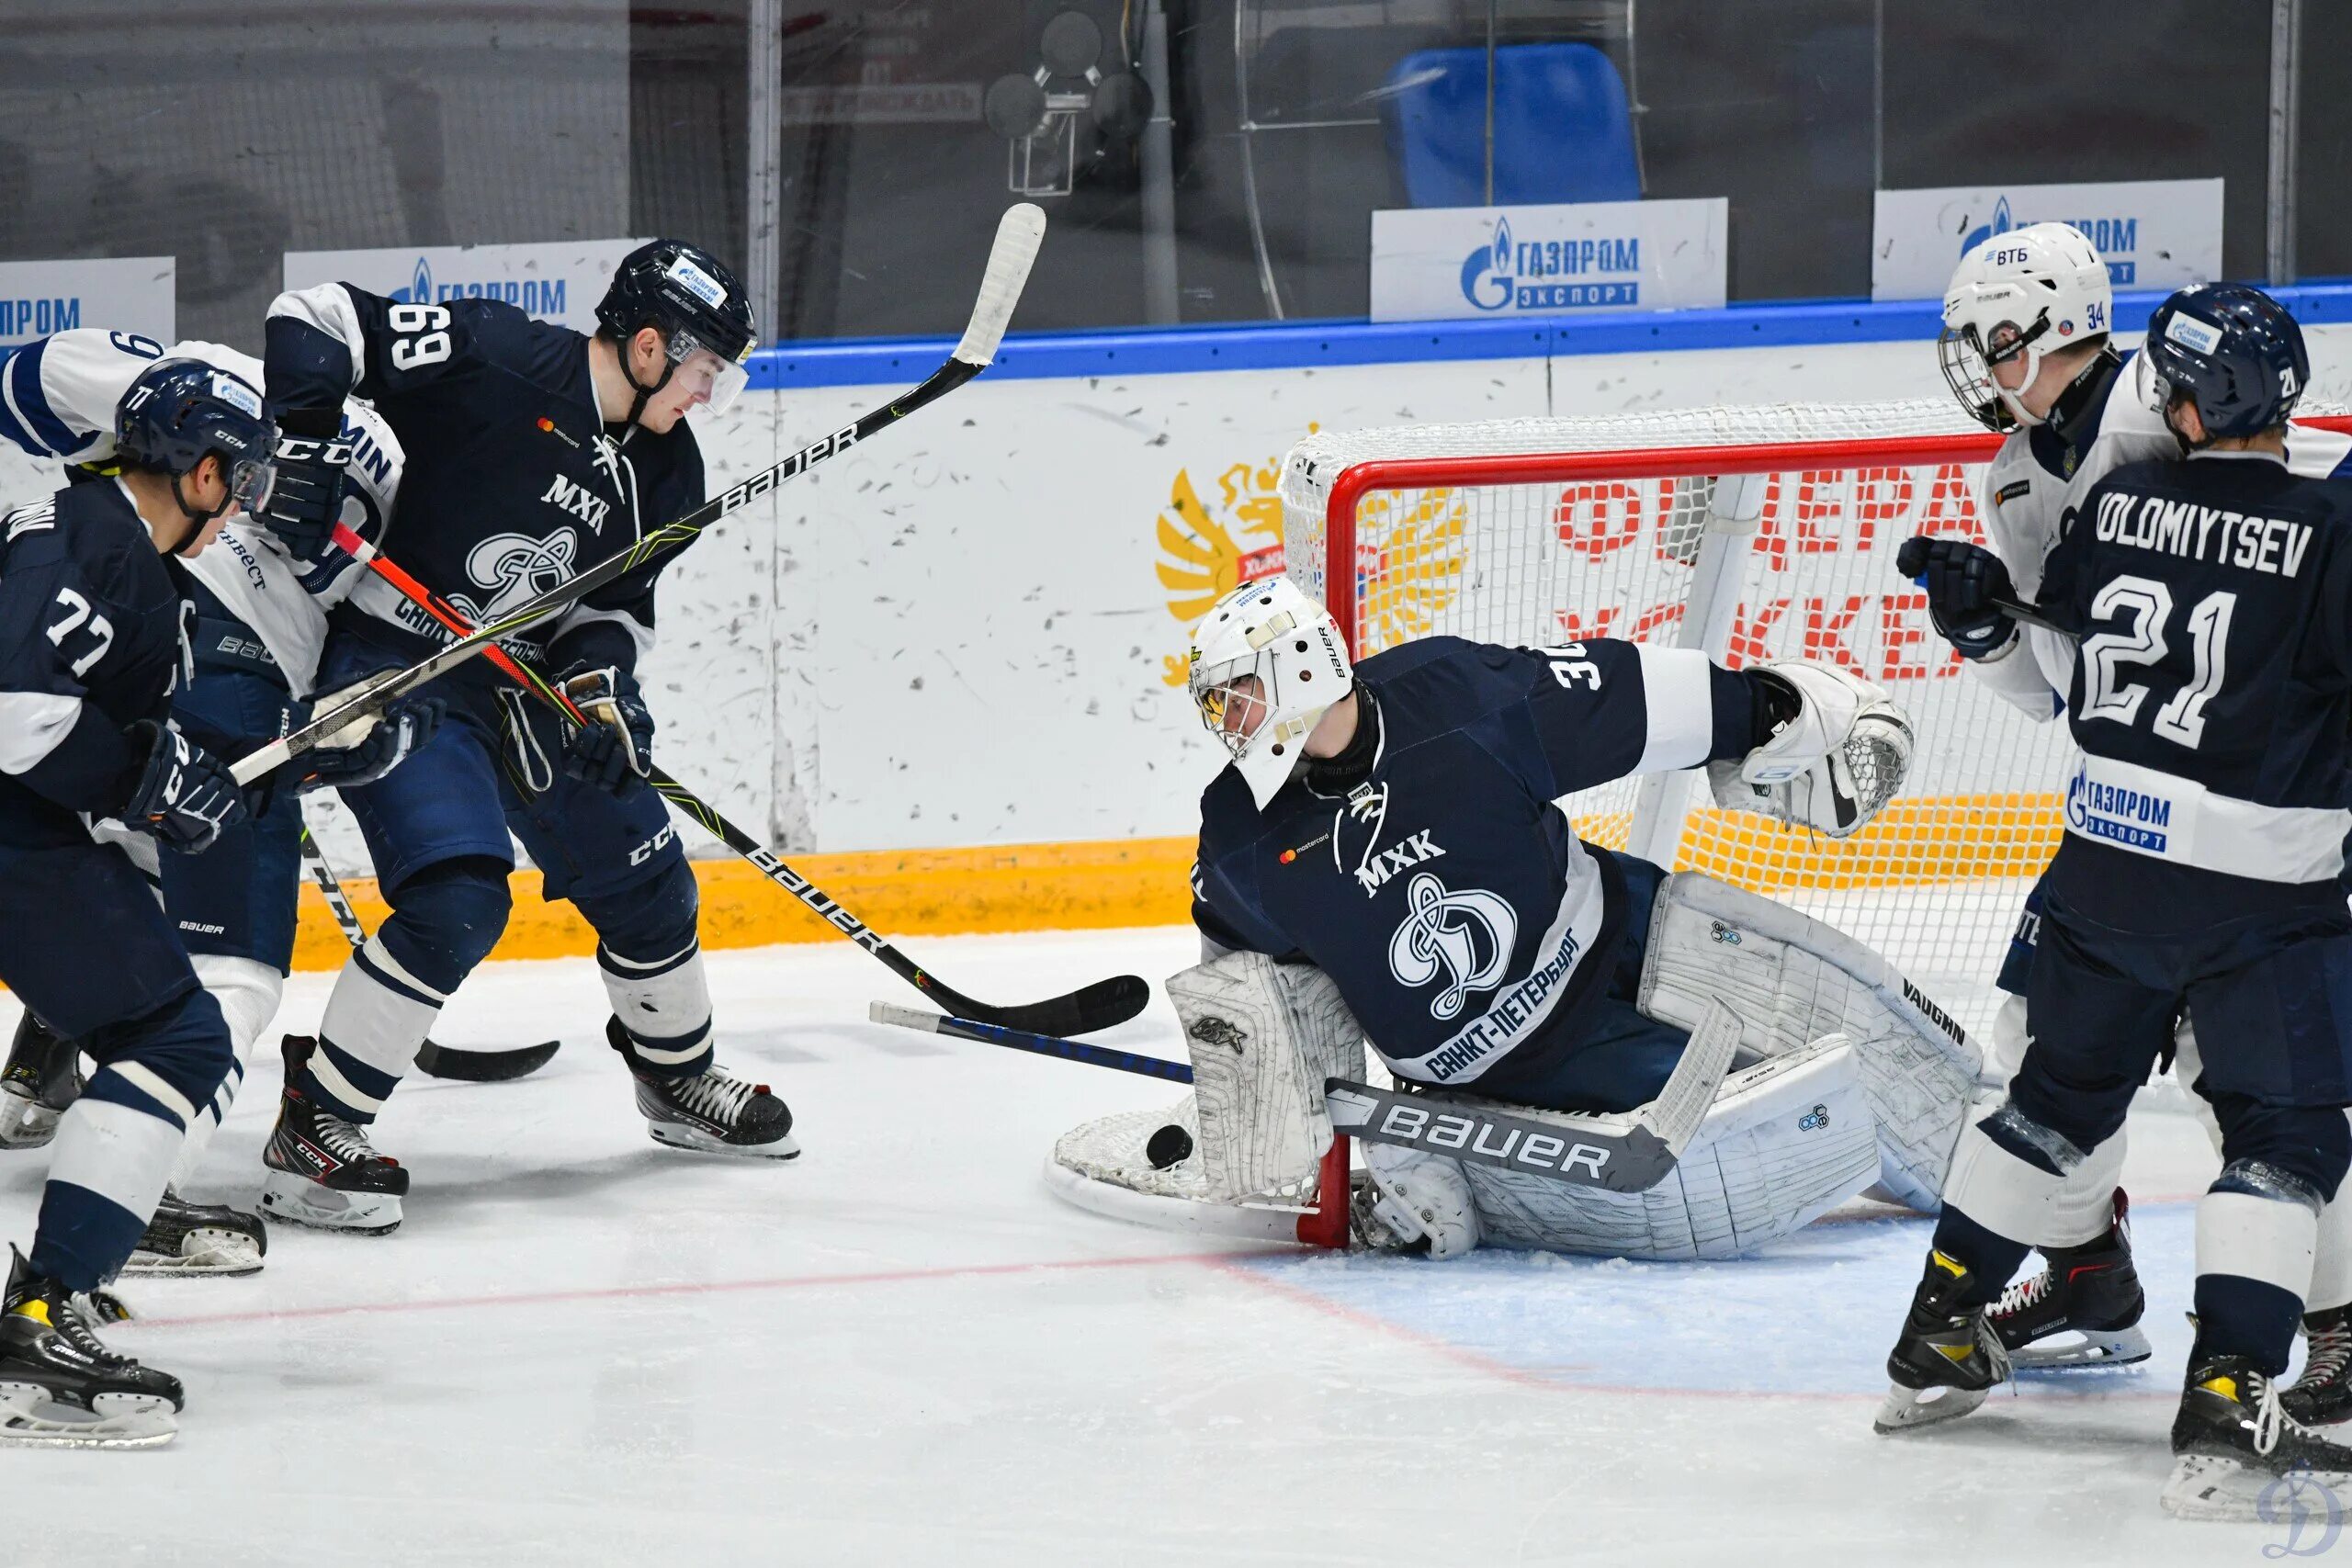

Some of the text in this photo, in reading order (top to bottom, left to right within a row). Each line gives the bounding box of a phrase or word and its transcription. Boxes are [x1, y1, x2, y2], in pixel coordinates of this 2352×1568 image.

[1517, 237, 1639, 276] ГАЗПРОМ
[1996, 248, 2028, 265] ВТБ
[1521, 285, 1634, 306] ЭКСПОРТ
[2086, 300, 2105, 330] 34
[389, 304, 452, 371] 69
[125, 385, 153, 412] 77
[214, 429, 248, 450] CCM
[553, 427, 581, 449] mastercard
[46, 587, 115, 678] 77
[2078, 574, 2237, 750] 21
[2088, 781, 2171, 828] ГАЗПРОМ
[1296, 833, 1329, 854] mastercard
[2088, 818, 2164, 850] ЭКСПОРТ
[1354, 829, 1446, 899] МХК
[1425, 927, 1580, 1081] САНКТ-ПЕТЕРБУРГ
[1904, 977, 1966, 1046] VAUGHN
[296, 1142, 328, 1170] CCM
